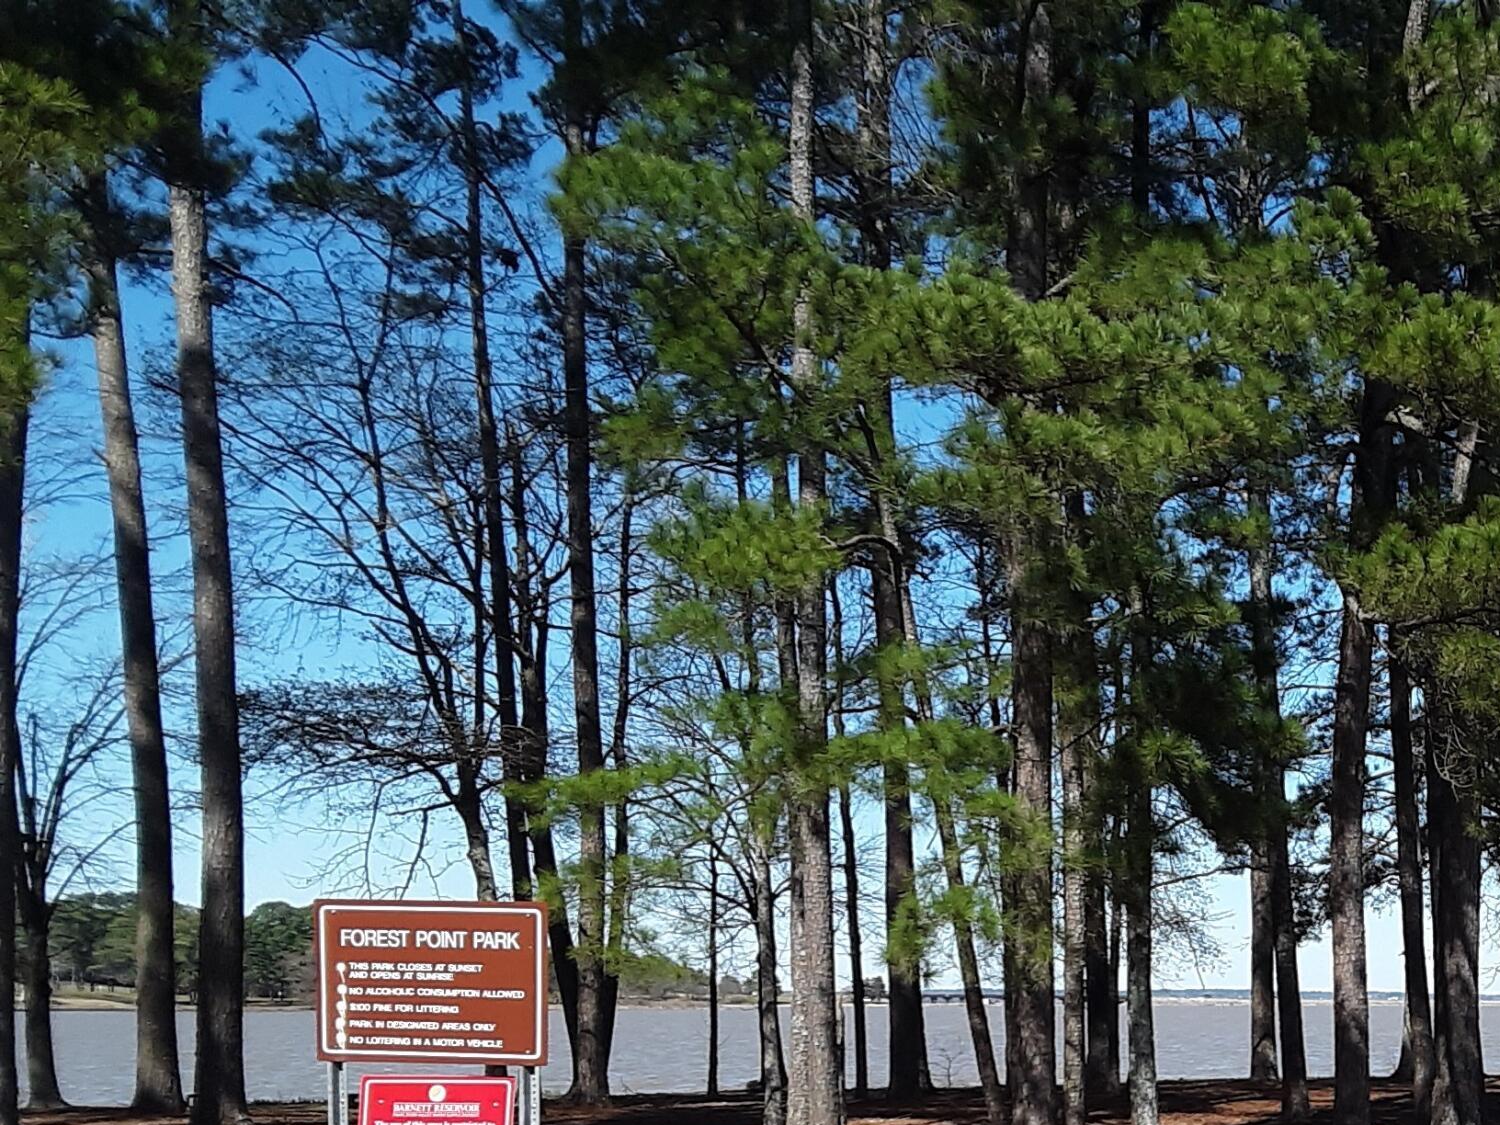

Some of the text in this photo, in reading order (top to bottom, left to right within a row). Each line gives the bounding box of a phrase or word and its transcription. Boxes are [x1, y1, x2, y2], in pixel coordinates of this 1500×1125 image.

[340, 929, 520, 950] FOREST POINT PARK
[348, 962, 484, 972] THIS PARK CLOSES AT SUNSET
[365, 988, 416, 996] ALCOHOLIC
[417, 988, 480, 997] CONSUMPTION
[482, 990, 526, 998] ALLOWED
[394, 1004, 414, 1012] FOR
[416, 1005, 459, 1014] LITTERING
[349, 1020, 373, 1028] PARK
[386, 1020, 440, 1030] DESIGNATED
[442, 1022, 470, 1030] AREAS
[472, 1023, 496, 1031] ONLY
[350, 1036, 504, 1048] NO LOITERING IN A MOTOR VEHICLE
